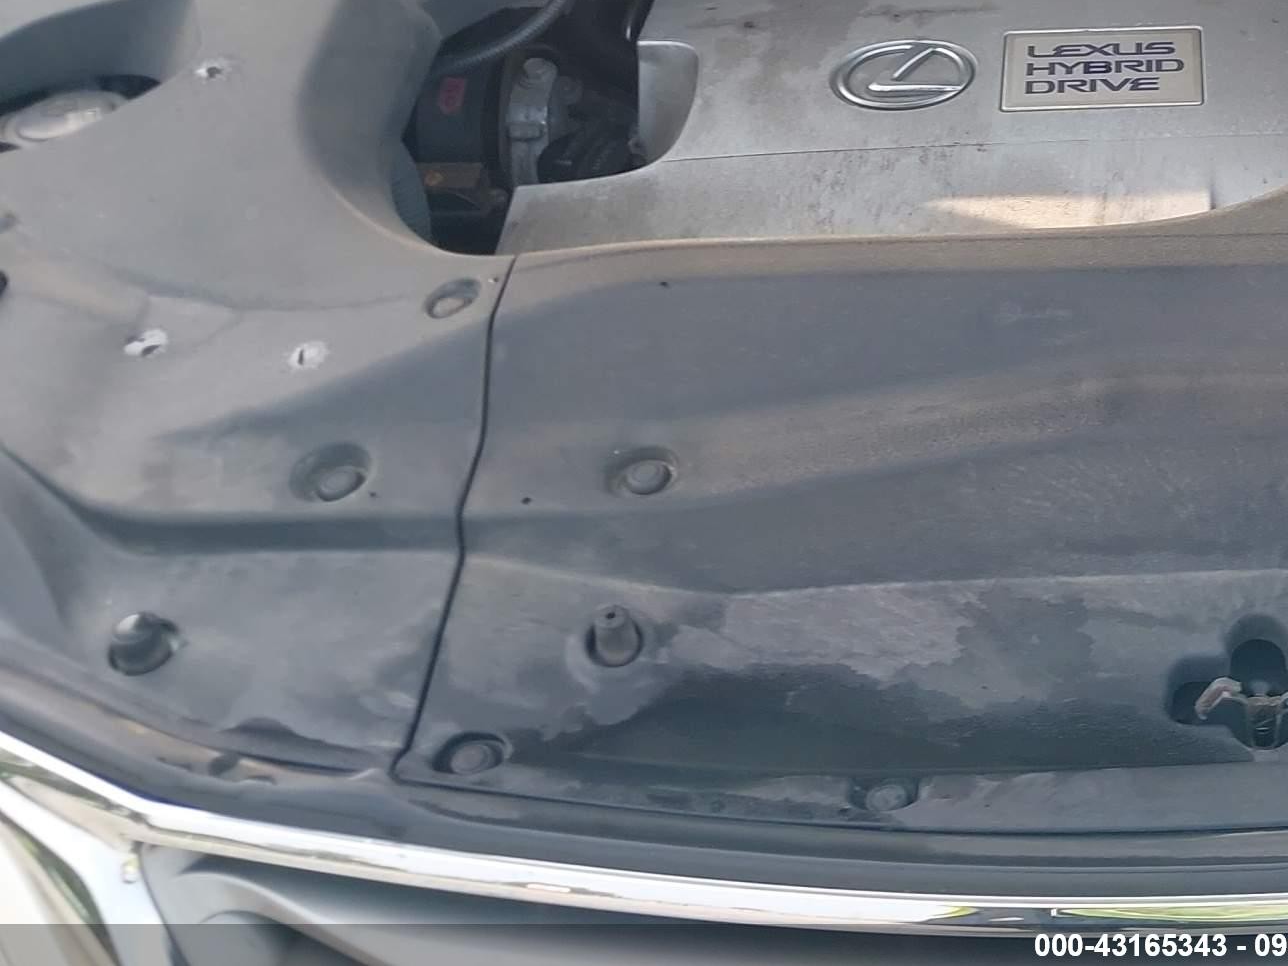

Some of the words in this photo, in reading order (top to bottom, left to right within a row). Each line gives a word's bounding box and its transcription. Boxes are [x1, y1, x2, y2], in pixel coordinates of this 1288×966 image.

[1027, 42, 1176, 58] LEXUS
[1025, 59, 1185, 76] HYBRID
[1024, 77, 1160, 94] DRIVE
